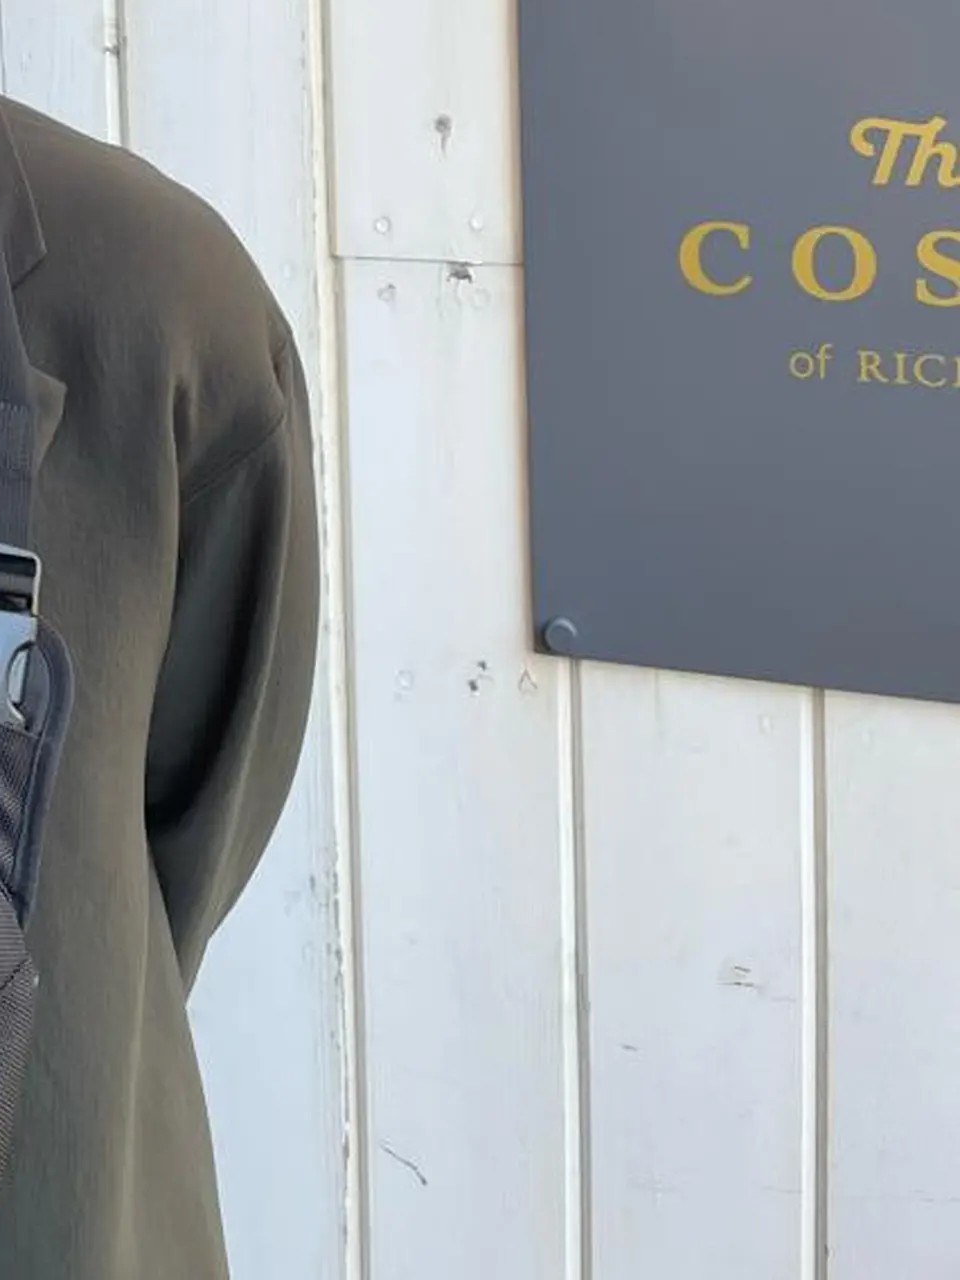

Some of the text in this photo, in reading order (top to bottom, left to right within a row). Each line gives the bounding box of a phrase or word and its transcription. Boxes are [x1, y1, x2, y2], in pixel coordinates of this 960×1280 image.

[677, 221, 960, 308] COS
[789, 342, 960, 388] of RIC
